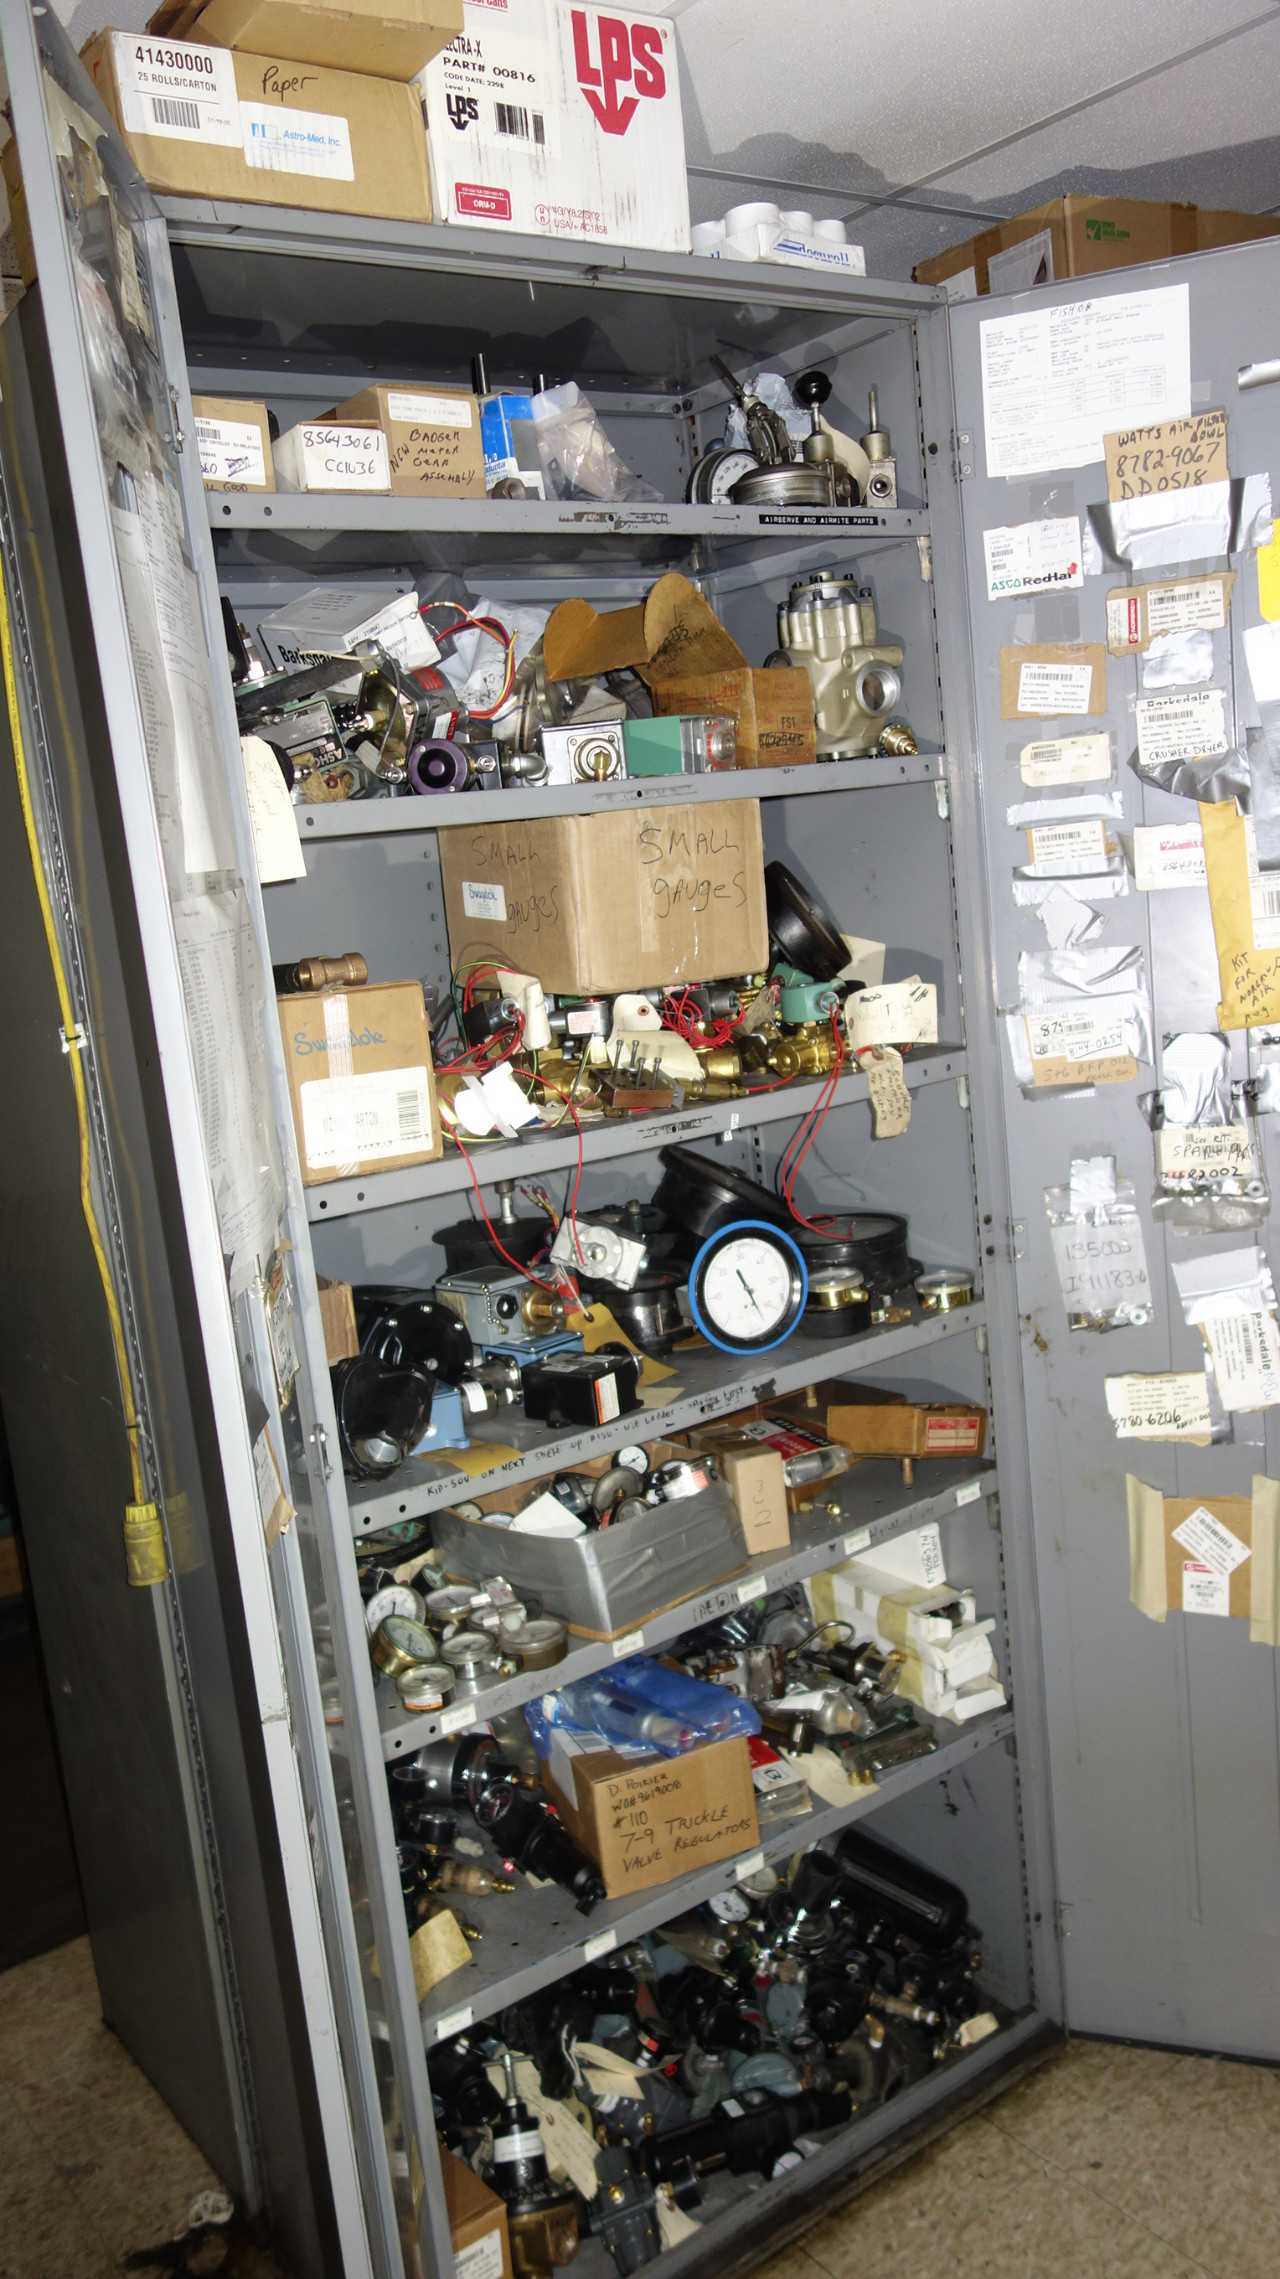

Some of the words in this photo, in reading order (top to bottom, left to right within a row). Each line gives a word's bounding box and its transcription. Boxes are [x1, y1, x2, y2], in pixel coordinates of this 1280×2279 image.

[134, 46, 214, 75] 41430000
[443, 56, 485, 73] PART#
[492, 66, 537, 83] 00816
[443, 71, 463, 81] CODE
[571, 9, 668, 115] LPS
[137, 71, 150, 81] 25
[151, 72, 218, 92] ROLLS/CARTON
[261, 65, 319, 103] Paper
[445, 92, 480, 124] LPS
[471, 835, 541, 867] SMALL
[639, 826, 740, 865] SMALL
[501, 1456, 528, 1474] NEXT
[664, 1804, 729, 1835] TRICKLE
[622, 1848, 664, 1874] VALVE
[673, 1816, 753, 1854] REGULATORS
